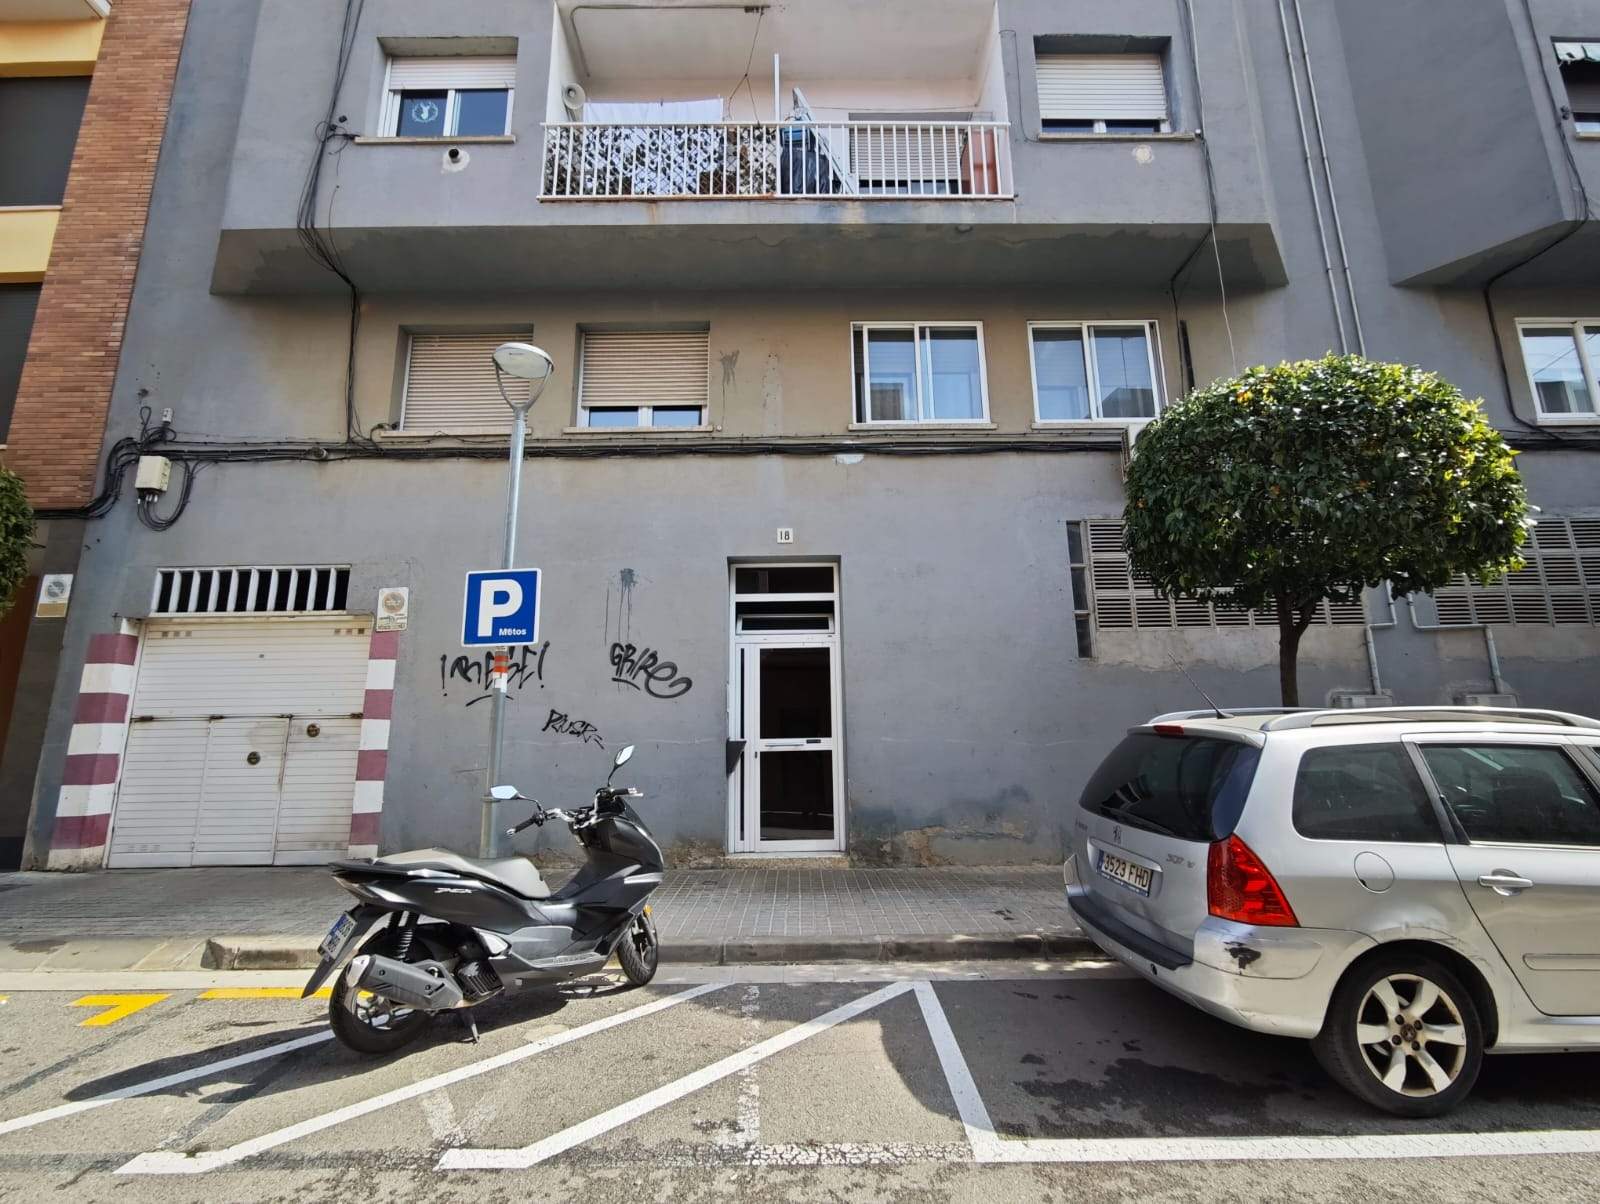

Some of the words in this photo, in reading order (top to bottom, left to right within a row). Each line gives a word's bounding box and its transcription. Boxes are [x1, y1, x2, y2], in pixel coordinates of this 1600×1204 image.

[780, 530, 790, 541] 18
[477, 579, 523, 637] P
[1104, 855, 1127, 878] 3523
[1128, 864, 1150, 888] FHD
